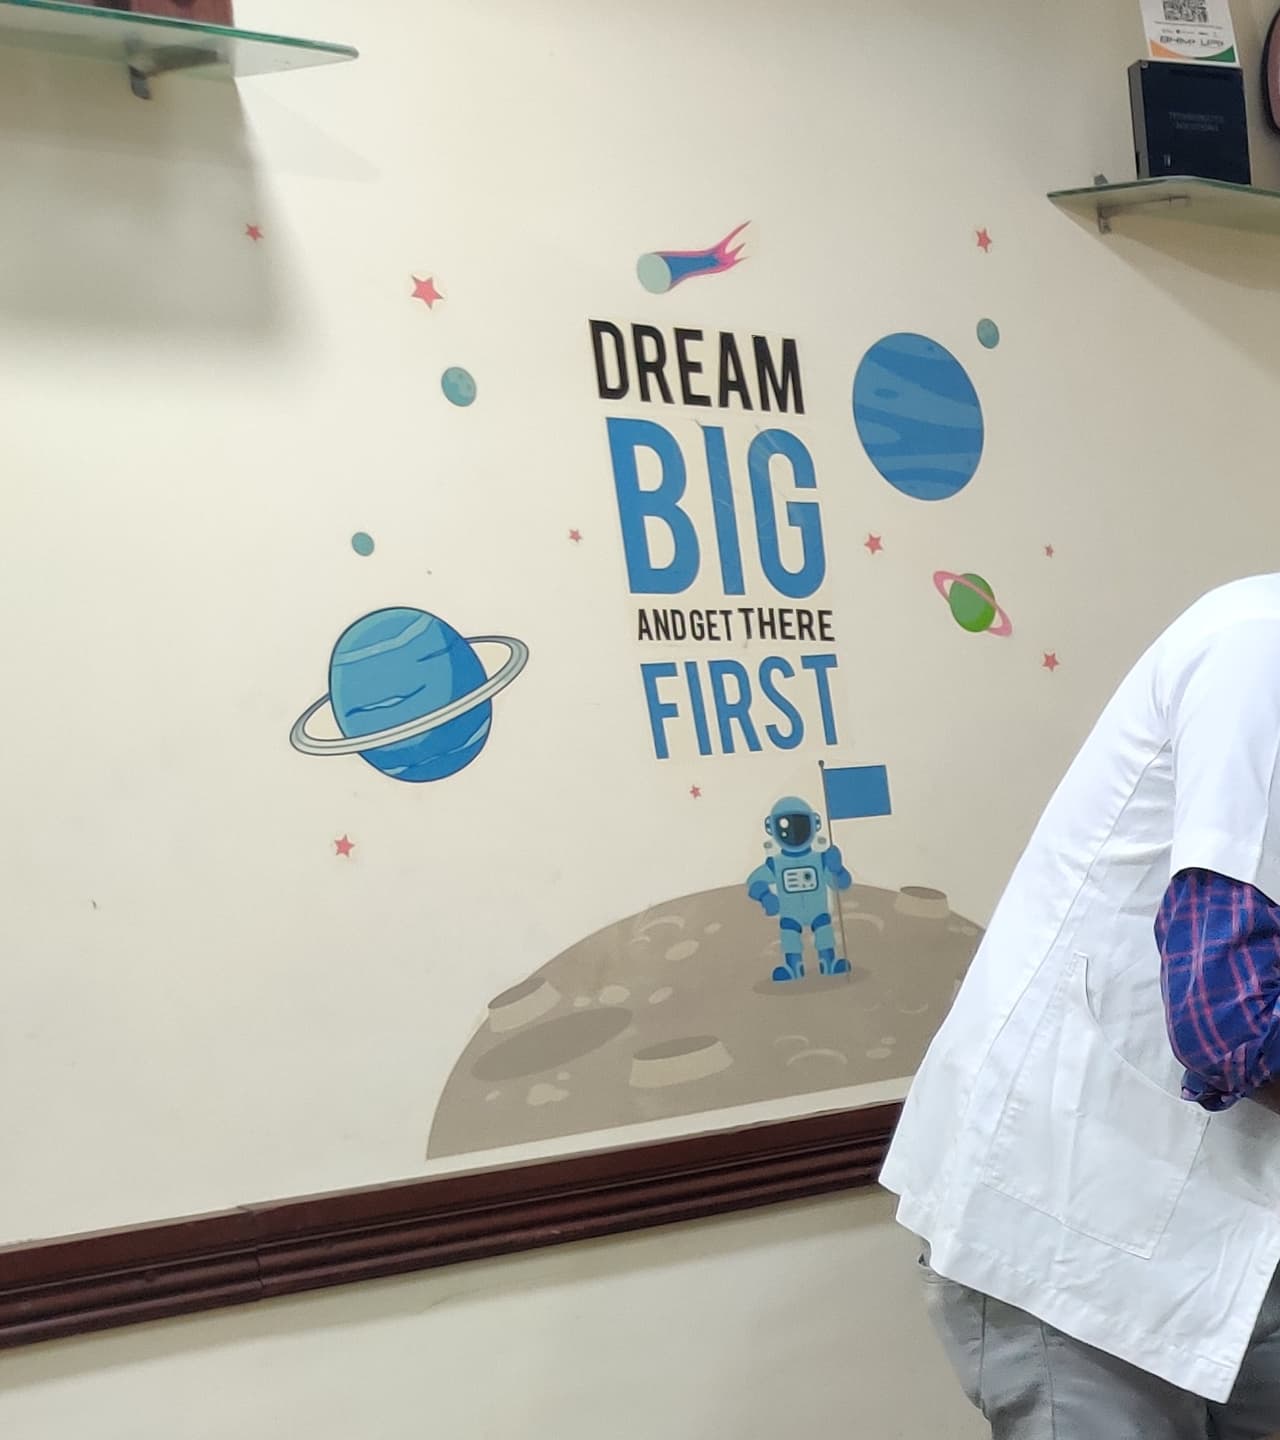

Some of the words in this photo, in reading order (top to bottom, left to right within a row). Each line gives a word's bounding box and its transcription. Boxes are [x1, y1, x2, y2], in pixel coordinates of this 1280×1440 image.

[589, 319, 805, 415] DREAM
[606, 417, 826, 599] BIG
[738, 607, 835, 642] THERE
[640, 654, 838, 759] FIRST
